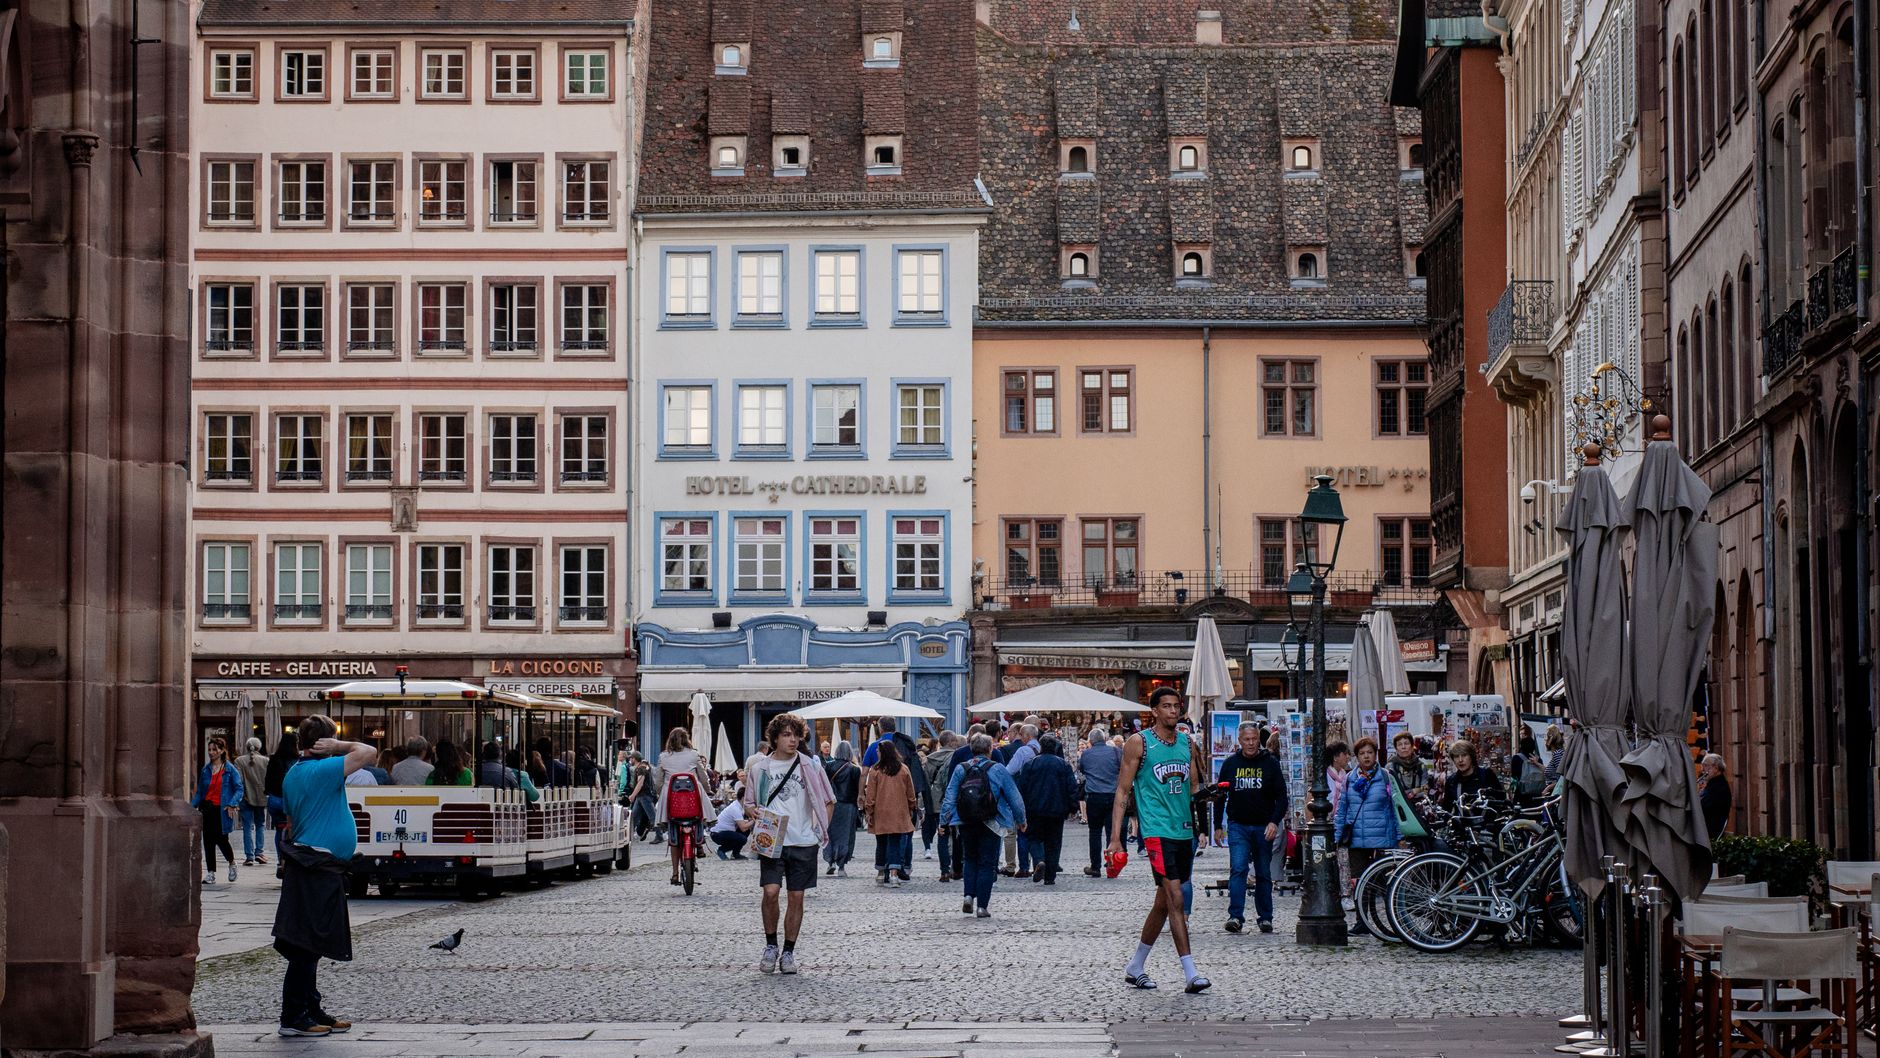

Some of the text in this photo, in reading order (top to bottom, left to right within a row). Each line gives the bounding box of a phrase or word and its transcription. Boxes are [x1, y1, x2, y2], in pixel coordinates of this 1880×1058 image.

[1304, 465, 1384, 487] HOTEL
[686, 475, 927, 496] HOTEL CATHEDRALE
[920, 646, 944, 654] HOTEL
[217, 662, 271, 676] CAFFE
[286, 661, 377, 676] GELATERIA
[490, 660, 604, 675] LA CIGOGNE
[1007, 655, 1091, 668] SOUVENIRS
[1100, 658, 1167, 671] D'ALSACE
[528, 683, 575, 694] CREPES
[581, 683, 606, 694] BAR
[690, 690, 851, 702] CFÉ BRASSERI
[1153, 761, 1190, 783] GRIZZLIES
[1168, 779, 1182, 794] 12
[1235, 777, 1263, 789] JONES
[394, 808, 407, 825] 40
